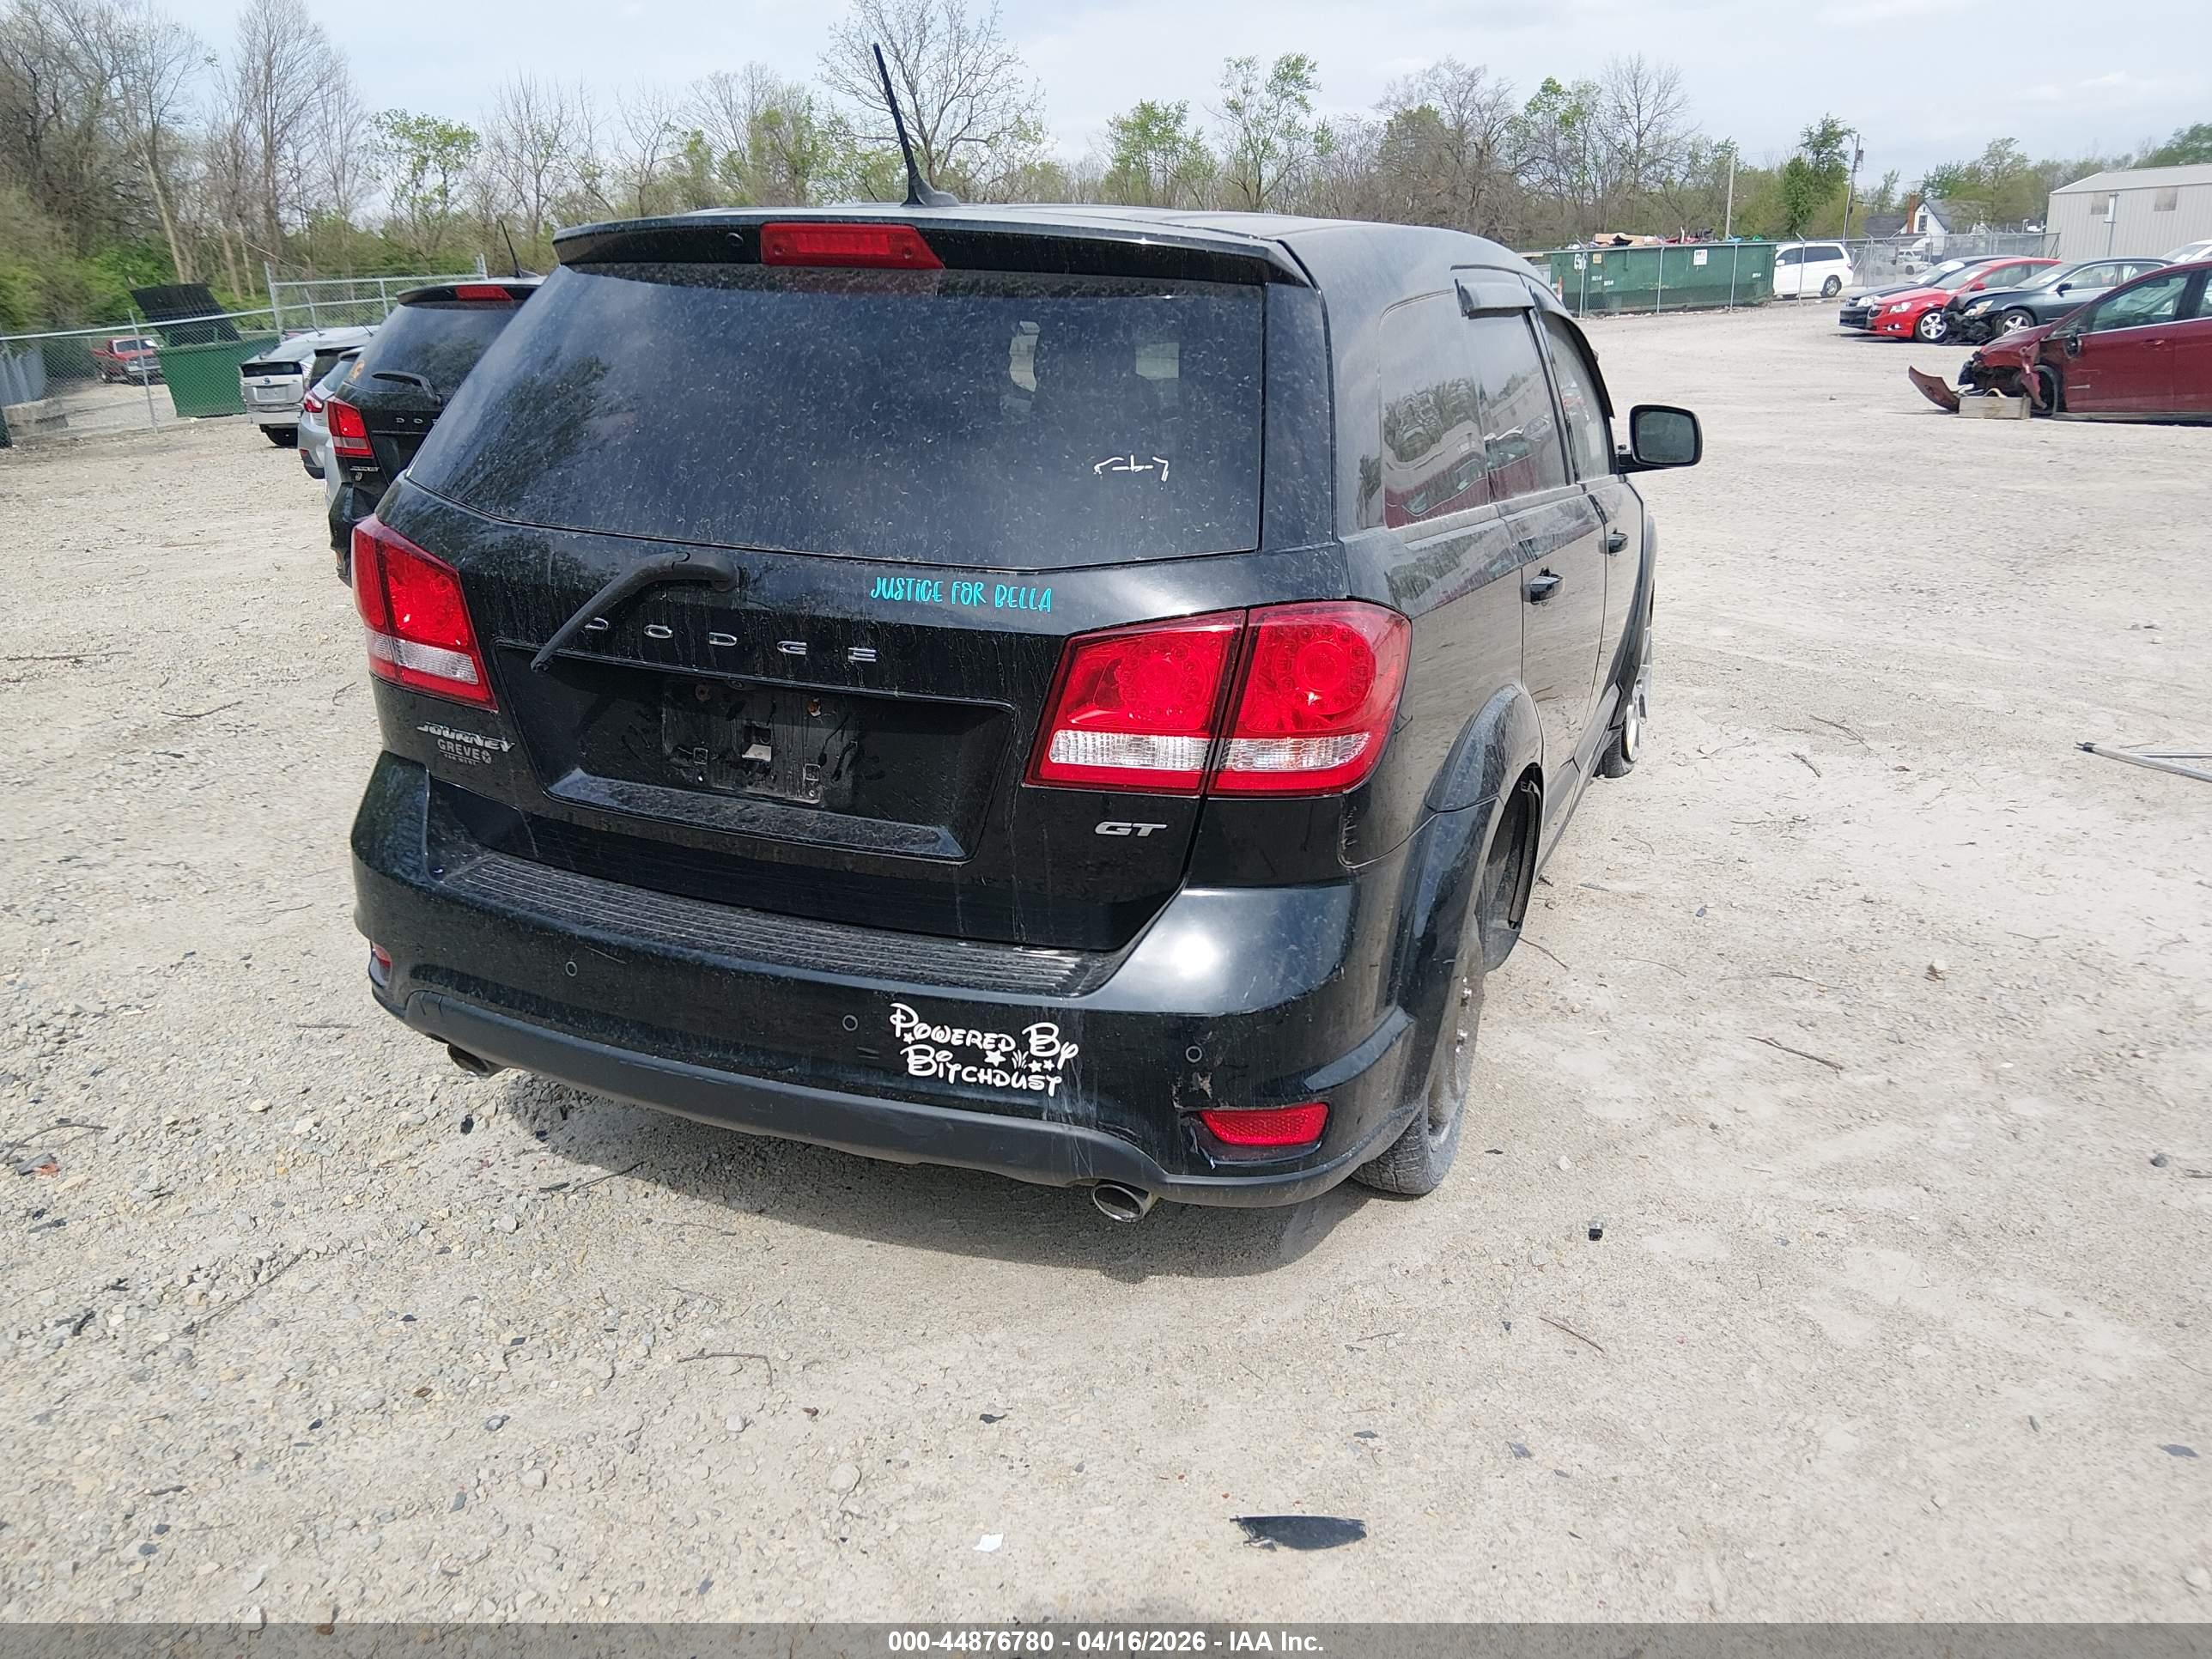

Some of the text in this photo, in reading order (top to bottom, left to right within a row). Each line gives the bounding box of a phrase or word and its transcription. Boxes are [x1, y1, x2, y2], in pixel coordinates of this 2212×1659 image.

[951, 580, 987, 606] FOR
[994, 584, 1052, 613] BELLA
[584, 617, 877, 663] DODGE
[416, 721, 516, 752] JOURNEY
[437, 738, 481, 761] GREVE
[1095, 821, 1168, 837] GT
